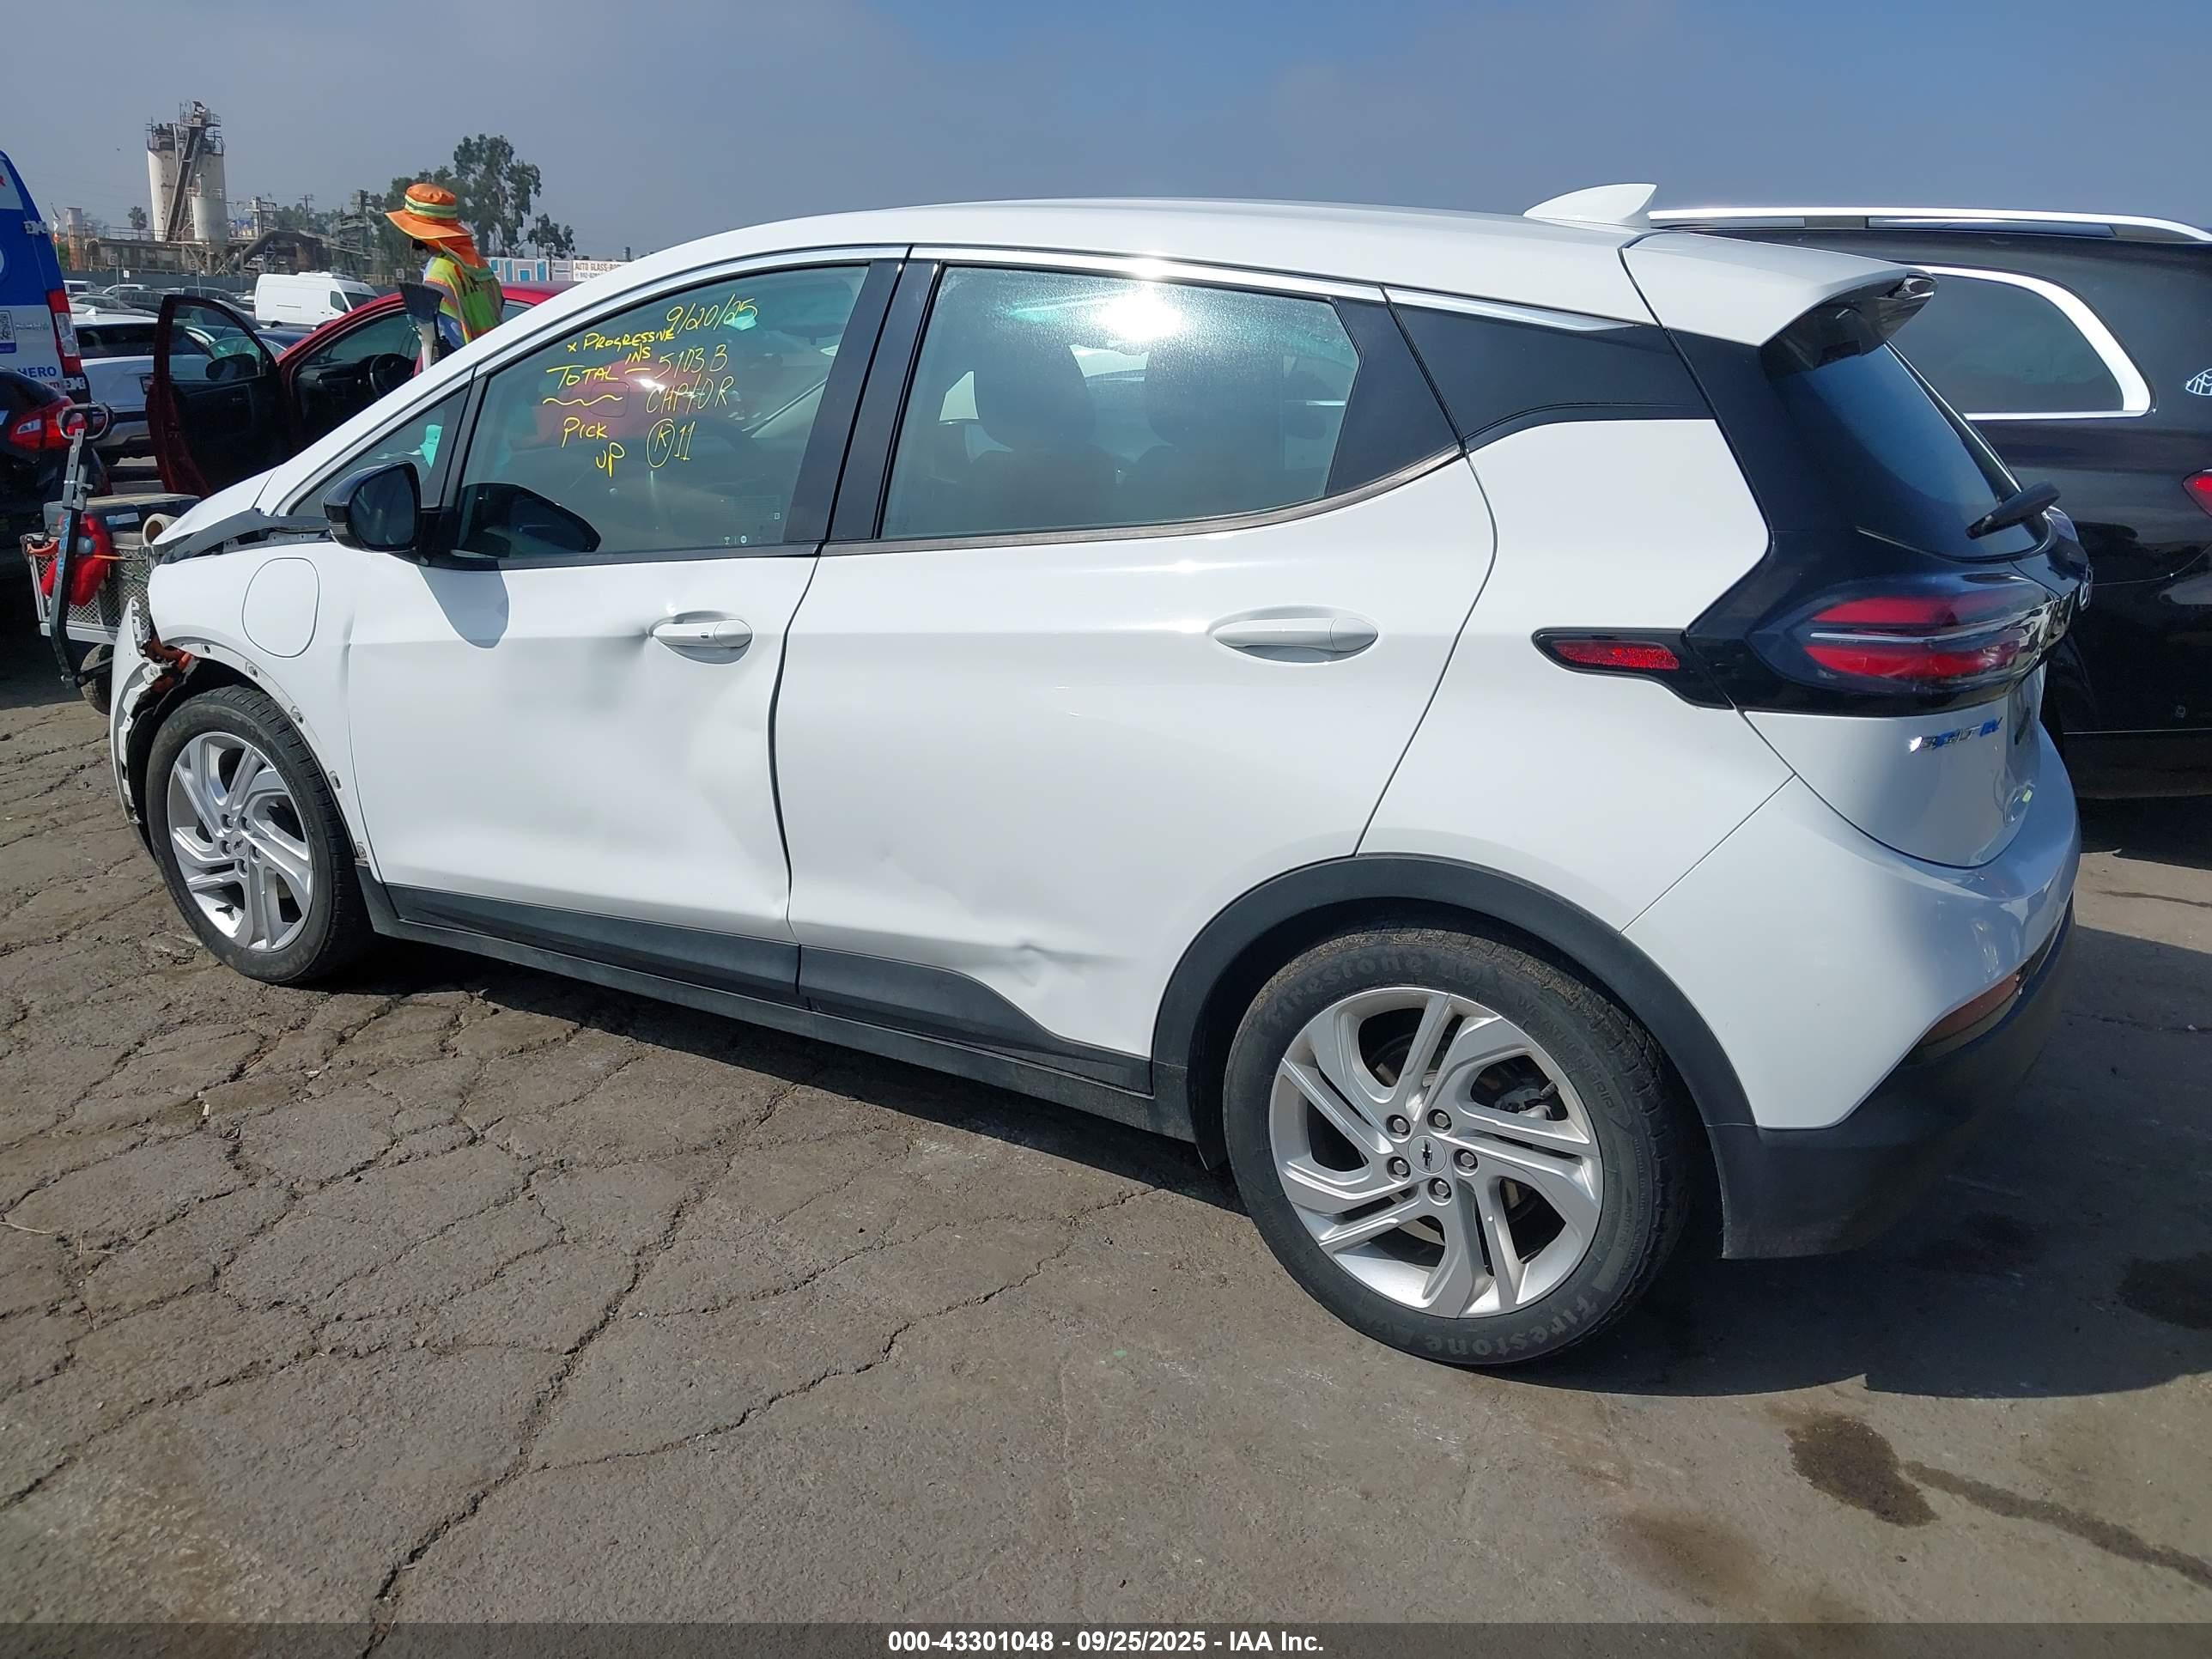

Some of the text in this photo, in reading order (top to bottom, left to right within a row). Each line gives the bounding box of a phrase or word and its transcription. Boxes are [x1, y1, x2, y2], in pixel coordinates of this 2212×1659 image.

[574, 262, 589, 271] AUTO
[666, 294, 759, 334] 9/20/25
[582, 327, 677, 353] PROGRESSIVE
[624, 343, 652, 366] INS
